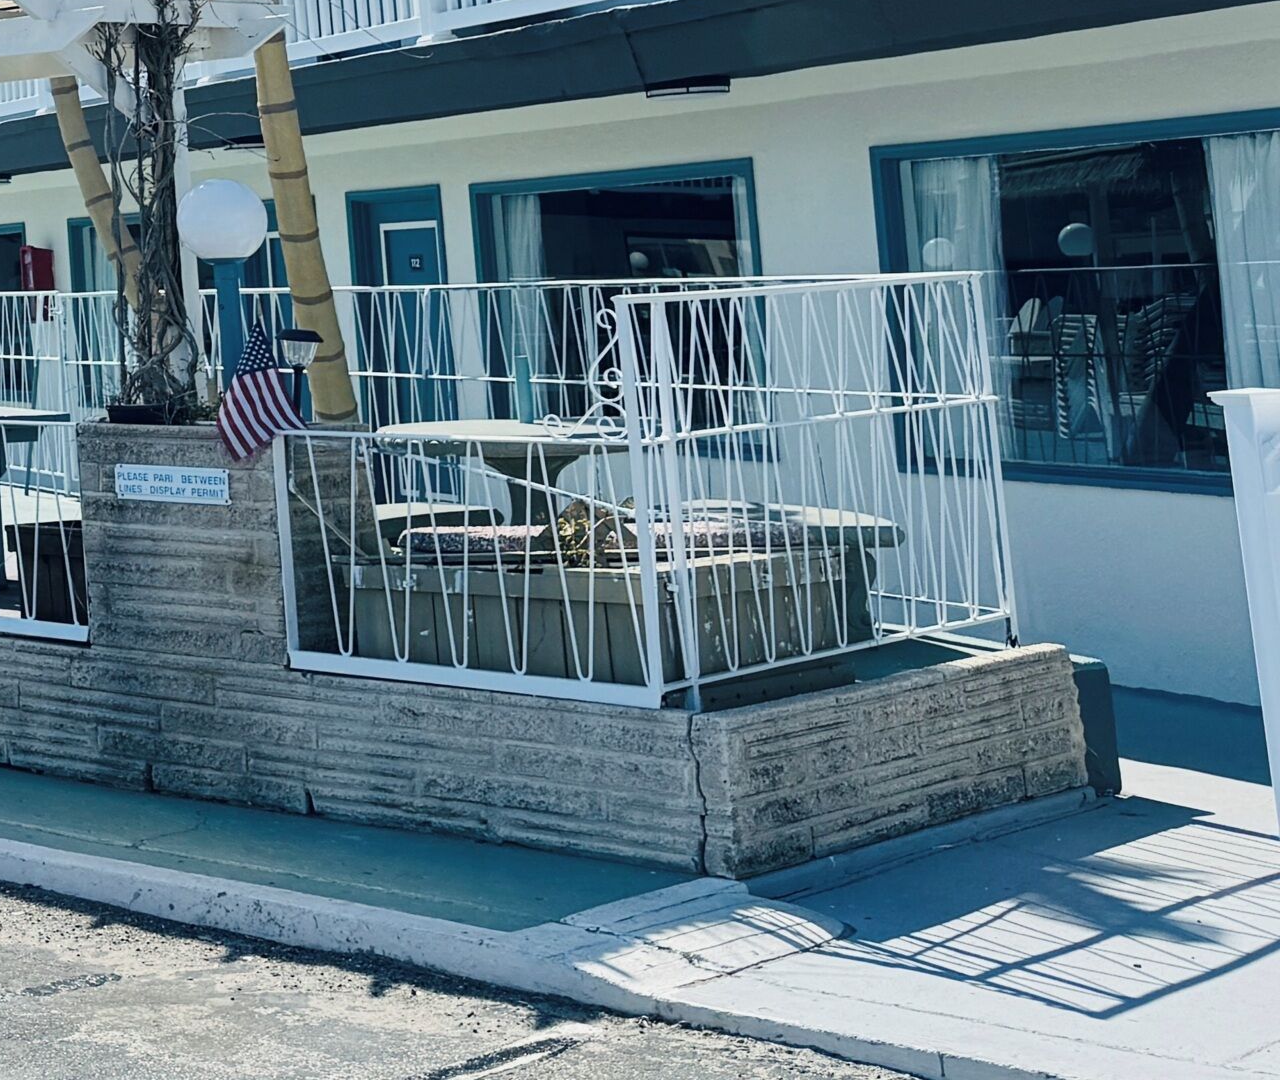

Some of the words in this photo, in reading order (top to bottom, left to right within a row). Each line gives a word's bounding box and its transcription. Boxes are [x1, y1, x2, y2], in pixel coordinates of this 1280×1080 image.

[117, 472, 148, 482] PLEASE
[181, 475, 226, 486] BETWEEN
[119, 484, 143, 494] LINES
[150, 486, 186, 496] DISPLAY
[191, 488, 225, 498] PERMIT
